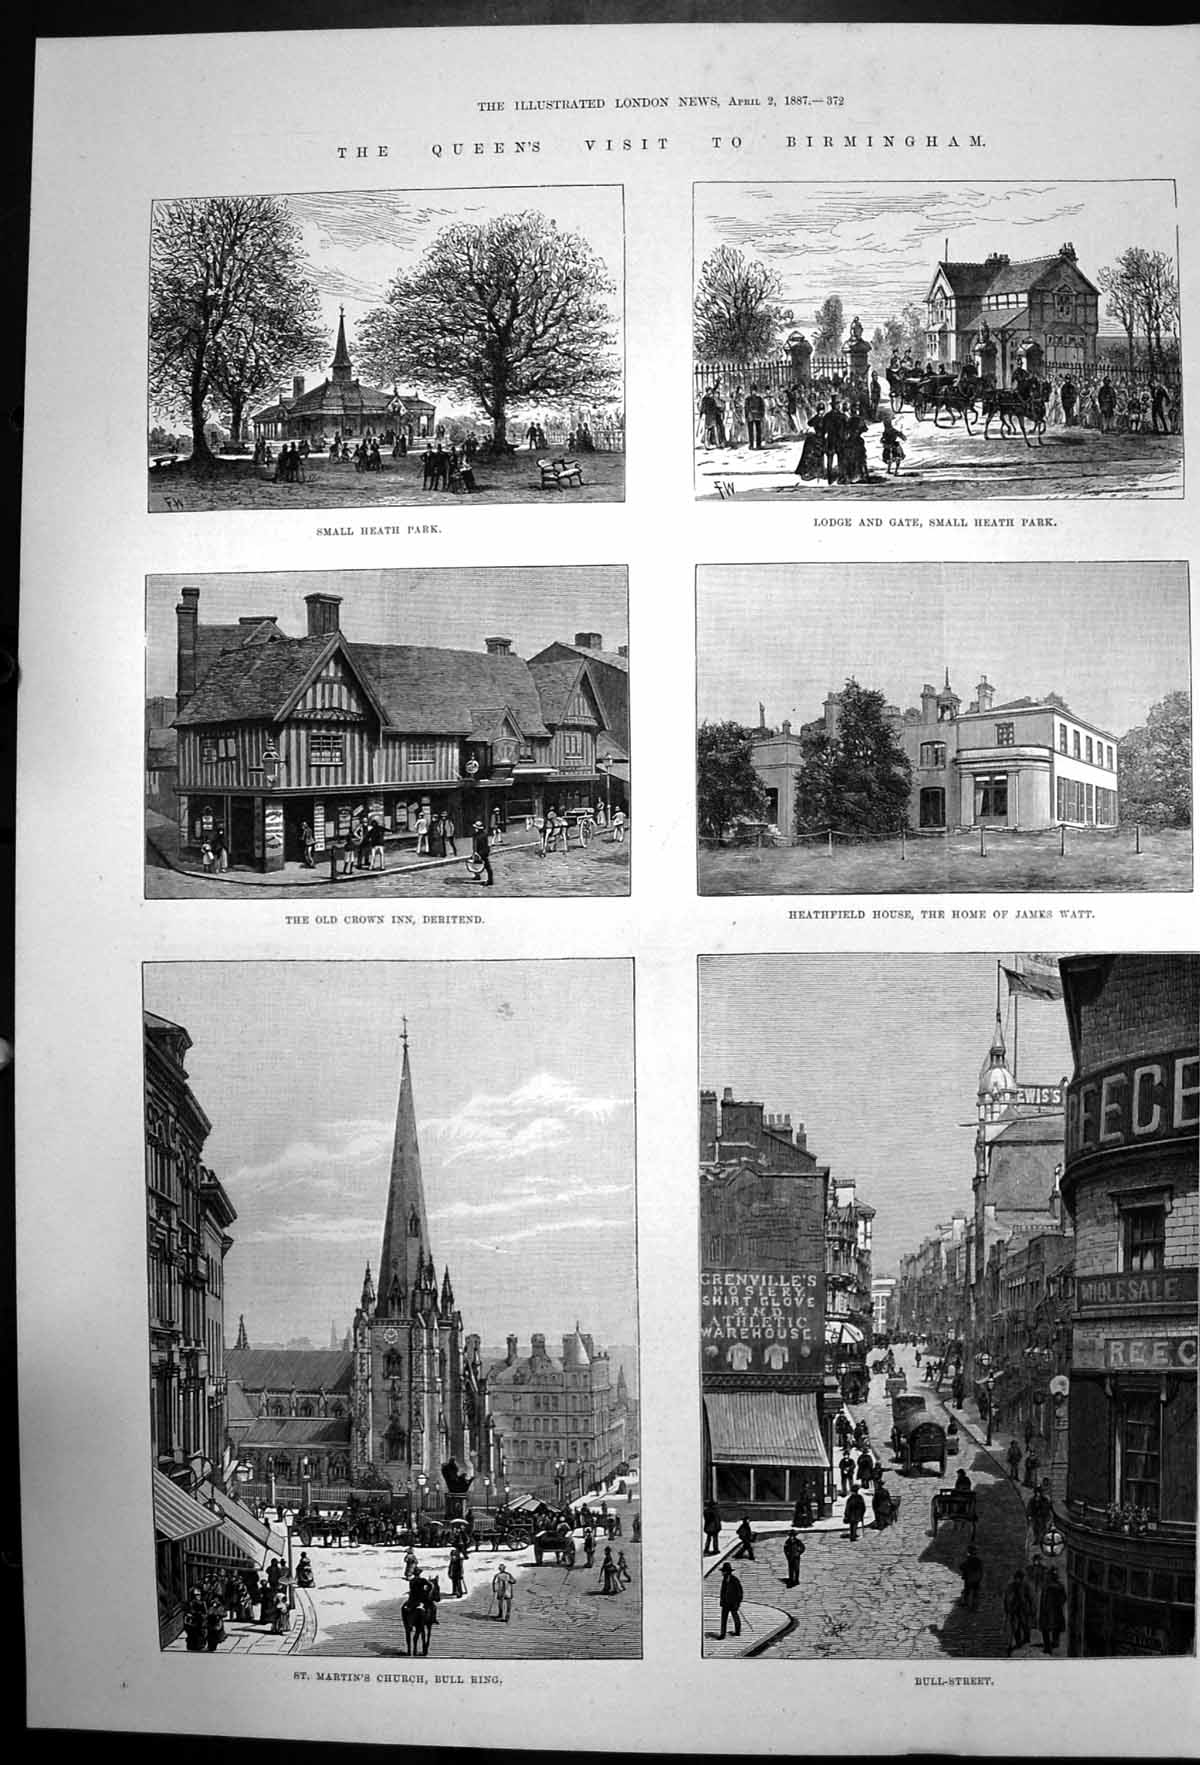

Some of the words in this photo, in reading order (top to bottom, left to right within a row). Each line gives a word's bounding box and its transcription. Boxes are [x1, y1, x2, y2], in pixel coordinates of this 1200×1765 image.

[476, 101, 505, 112] THE
[514, 98, 606, 111] ILLUSTRATED
[615, 96, 669, 109] LONDON
[678, 96, 721, 108] NEWS,
[767, 95, 777, 108] 2,
[336, 145, 389, 160] THE
[431, 140, 541, 159] QUEEN'S
[583, 137, 668, 152] VISIT
[711, 136, 742, 149] TO
[785, 135, 987, 148] BIRMINGHAM.
[813, 517, 853, 528] LODGE
[858, 517, 884, 528] AND
[888, 517, 924, 529] GATE,
[928, 517, 969, 528] SMALL
[973, 517, 1015, 528] HEATH
[1020, 517, 1058, 528] PARK.
[315, 526, 355, 537] SMALL
[359, 525, 400, 536] HEATH
[407, 524, 443, 535] PARK.
[284, 915, 310, 925] THE
[314, 915, 339, 925] OLD
[343, 914, 385, 925] CROWN
[391, 914, 416, 926] INN,
[422, 914, 485, 925] DERITEND.
[787, 909, 866, 920] HEATHFIELD
[871, 909, 915, 921] HOUSE,
[920, 909, 945, 920] THE
[951, 909, 987, 920] HOME
[992, 909, 1009, 920] OF
[1015, 909, 1053, 920] JAMES
[1058, 909, 1096, 919] WATT.
[702, 1296, 752, 1306] SHIRT
[760, 1296, 815, 1308] GLOVE
[710, 1315, 807, 1329] ATHLETIC
[293, 1671, 311, 1681] ST.
[315, 1671, 371, 1683] MARTIN'S
[376, 1673, 429, 1685] CHURCH,
[434, 1674, 465, 1684] BULL
[470, 1675, 503, 1685] RING.
[914, 1676, 995, 1687] BULL-STREET.
